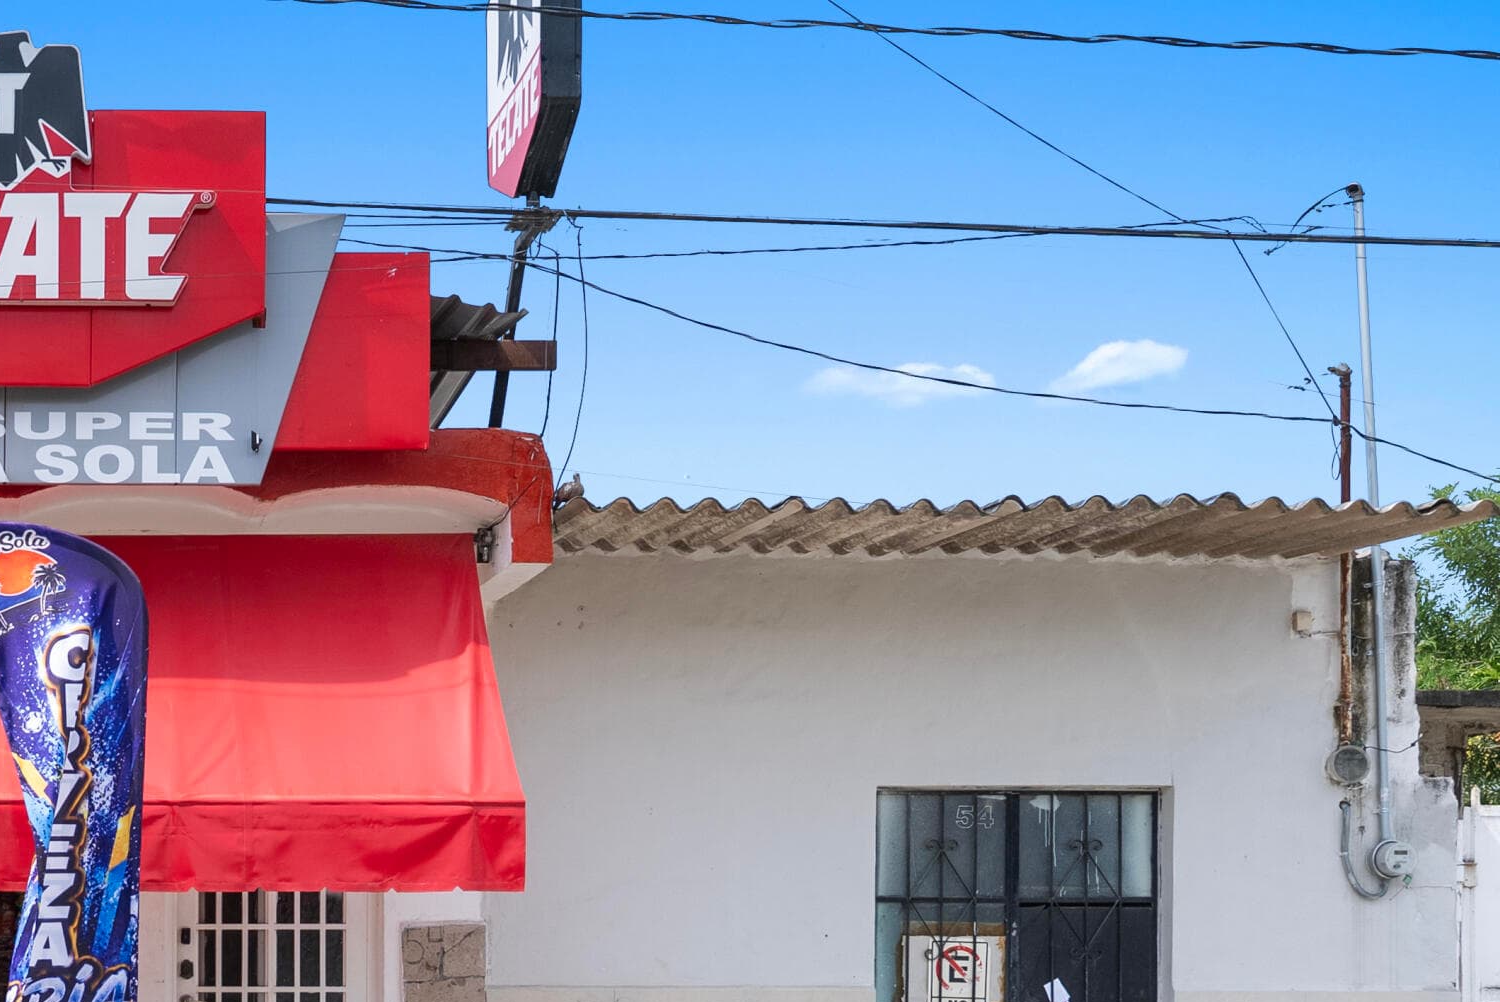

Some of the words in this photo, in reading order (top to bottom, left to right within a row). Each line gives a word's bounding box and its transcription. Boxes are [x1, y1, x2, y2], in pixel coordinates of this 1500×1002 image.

[488, 52, 541, 177] TECATE
[33, 444, 236, 484] SOLA
[955, 805, 995, 829] 54
